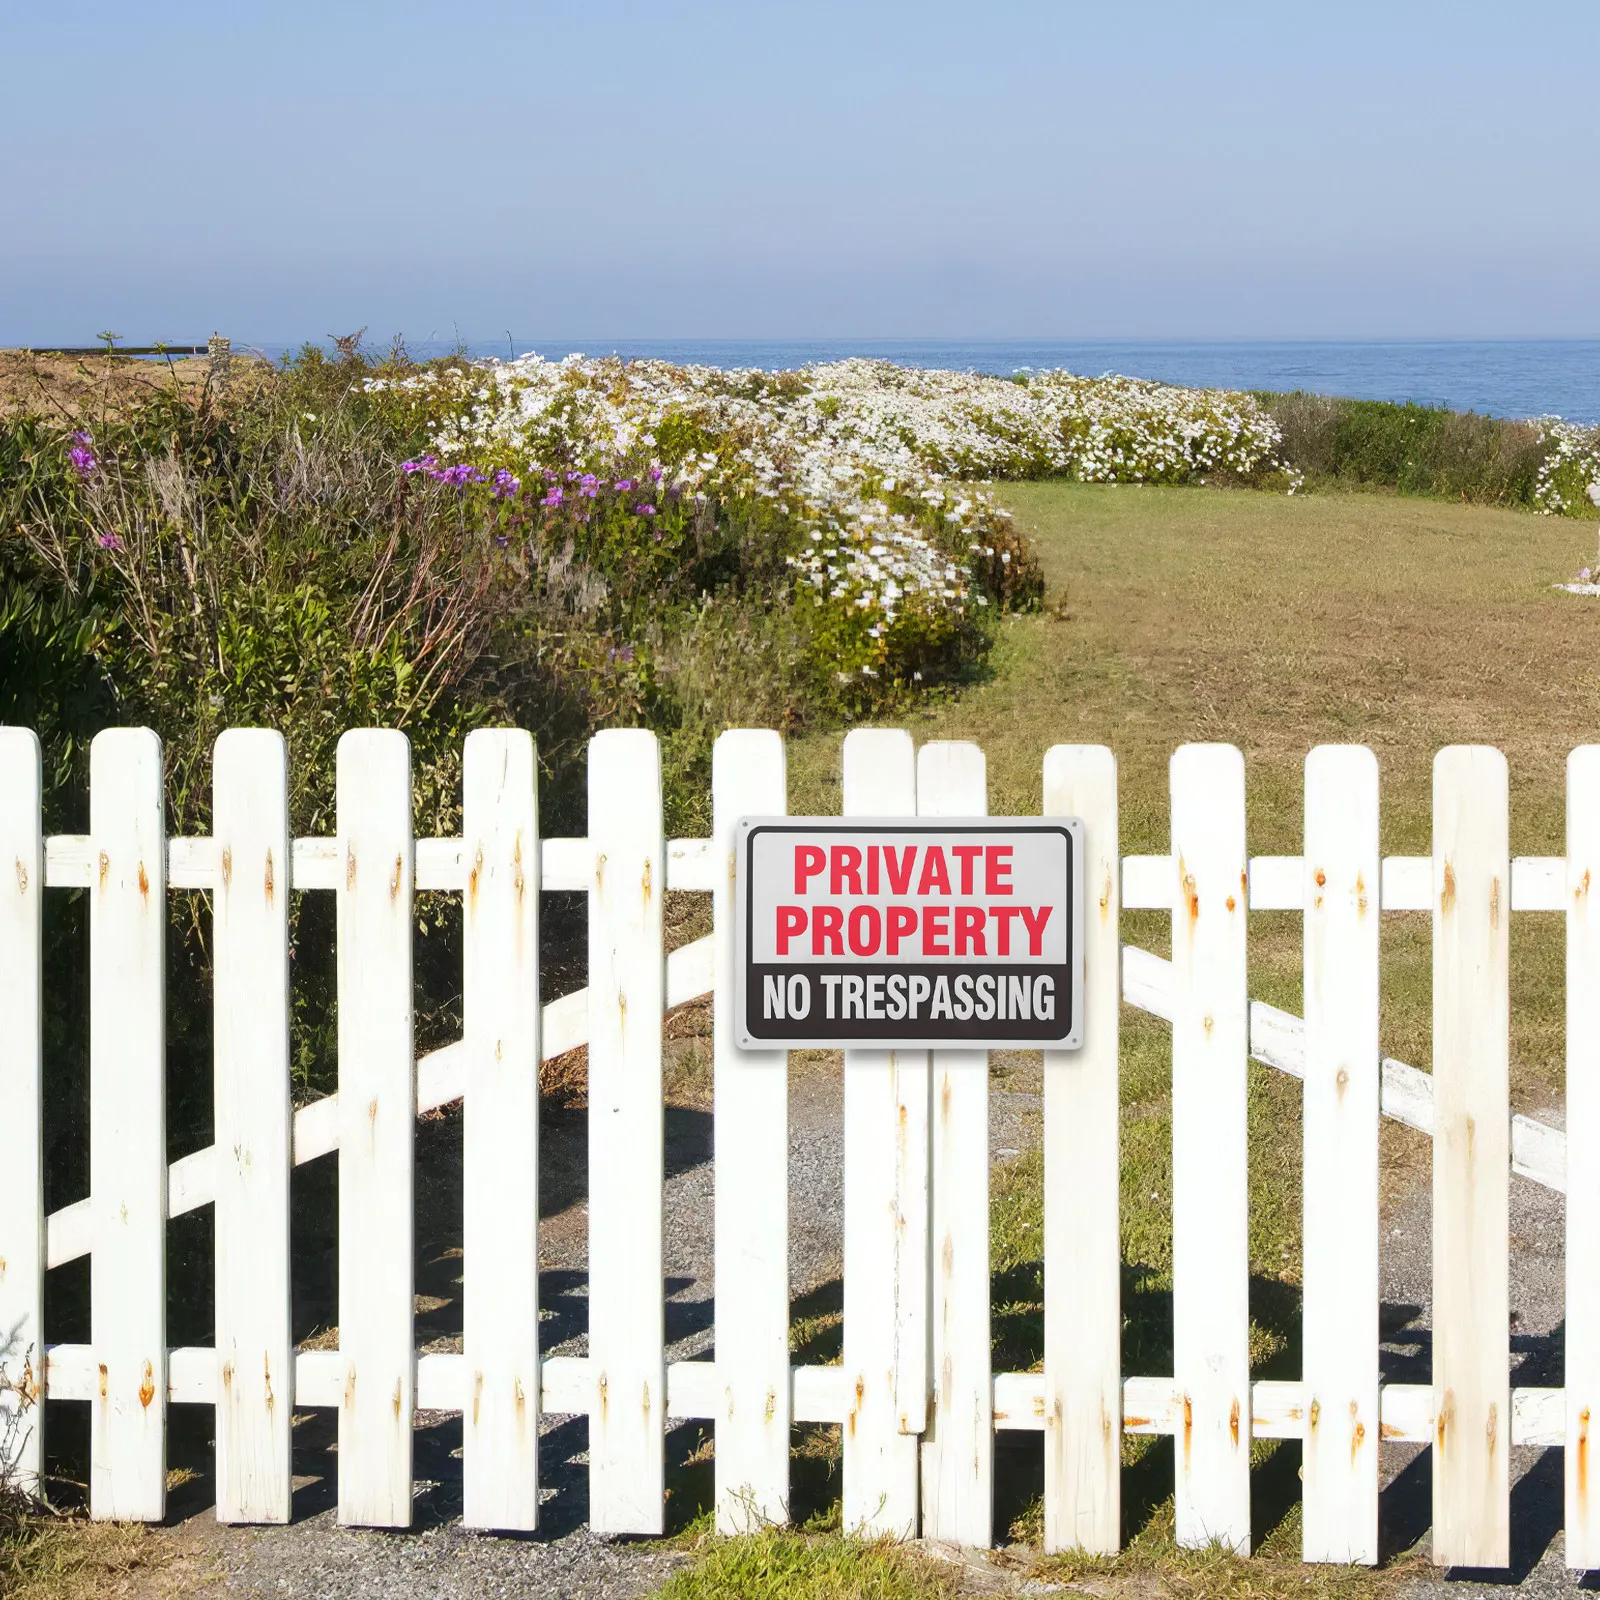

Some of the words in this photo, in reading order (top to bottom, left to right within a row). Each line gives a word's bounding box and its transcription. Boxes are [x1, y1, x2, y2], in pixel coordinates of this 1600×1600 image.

[794, 846, 1014, 895] PRIVATE
[776, 905, 1053, 957] PROPERTY
[763, 974, 811, 1020] NO
[820, 974, 1055, 1020] TRESPASSING
